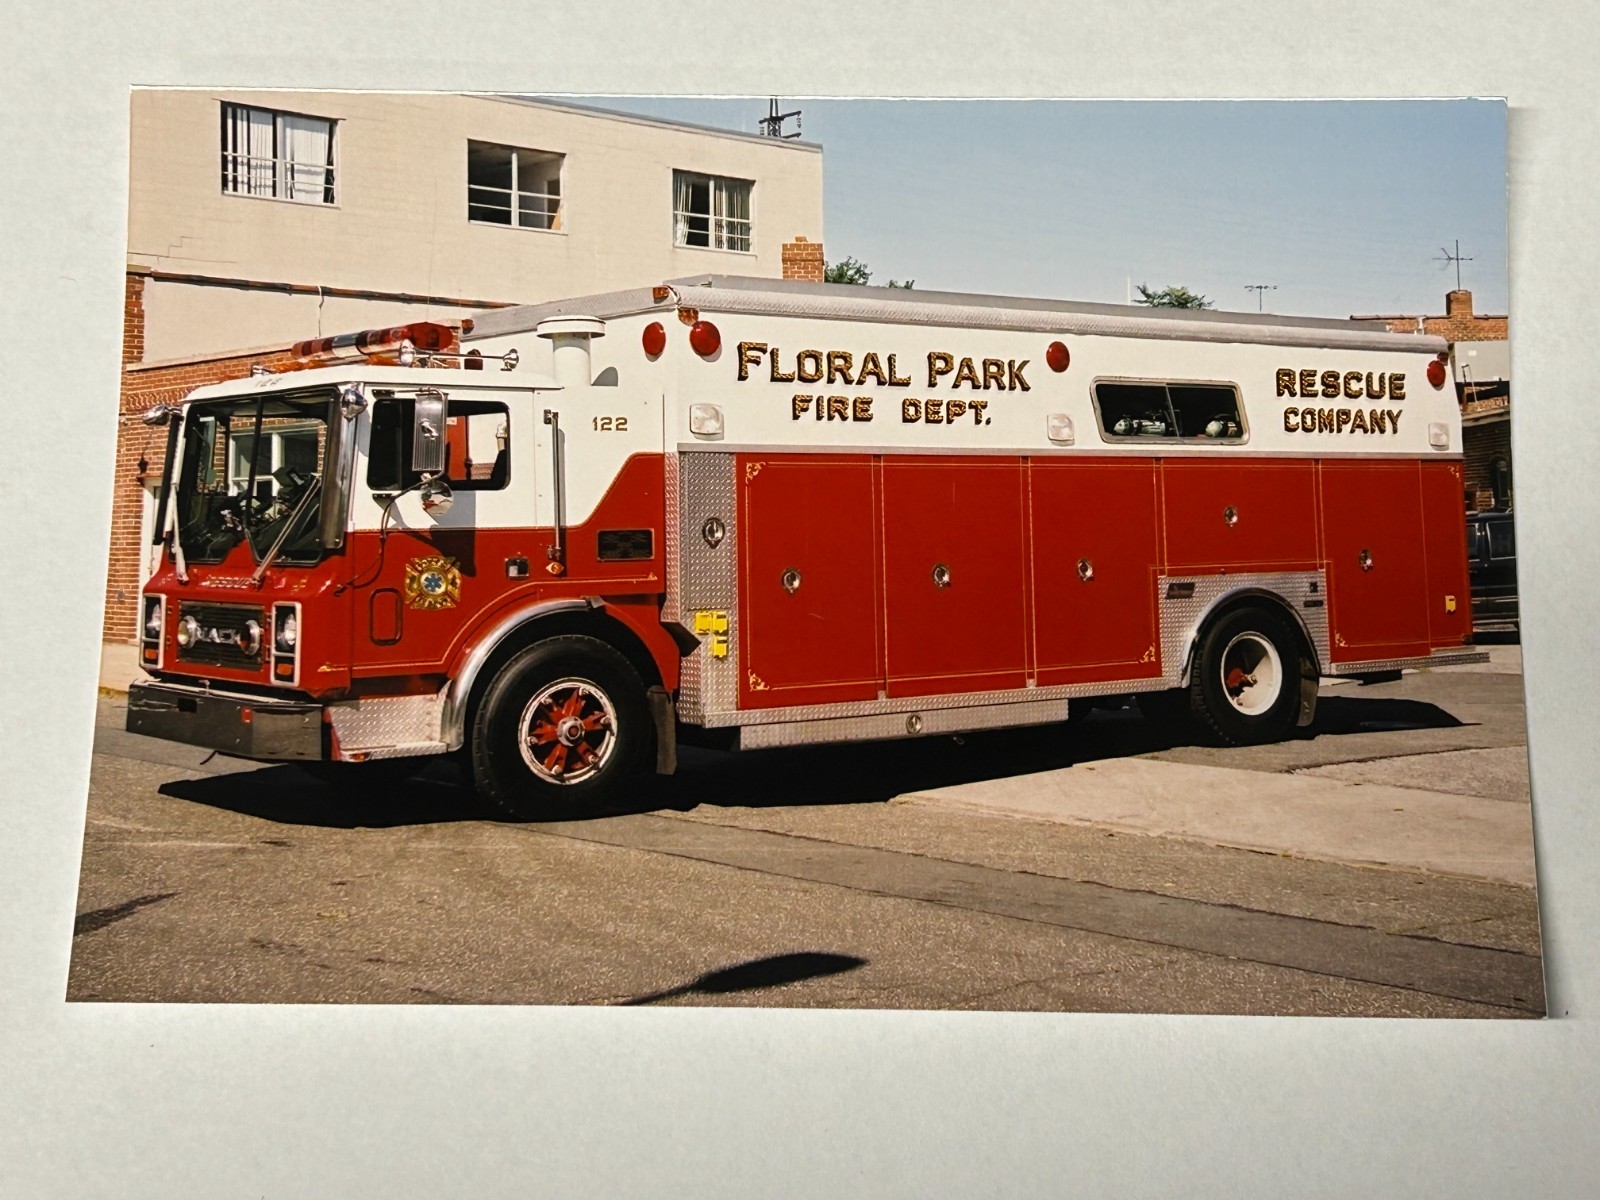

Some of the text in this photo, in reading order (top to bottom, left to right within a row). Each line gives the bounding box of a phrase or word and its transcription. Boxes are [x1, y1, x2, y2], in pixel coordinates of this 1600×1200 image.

[736, 341, 1032, 392] FLORAL PARK
[1275, 367, 1407, 400] RESCUE
[592, 416, 628, 432] 122
[791, 394, 992, 426] FIRE DEPT.
[1283, 406, 1404, 435] COMPANY
